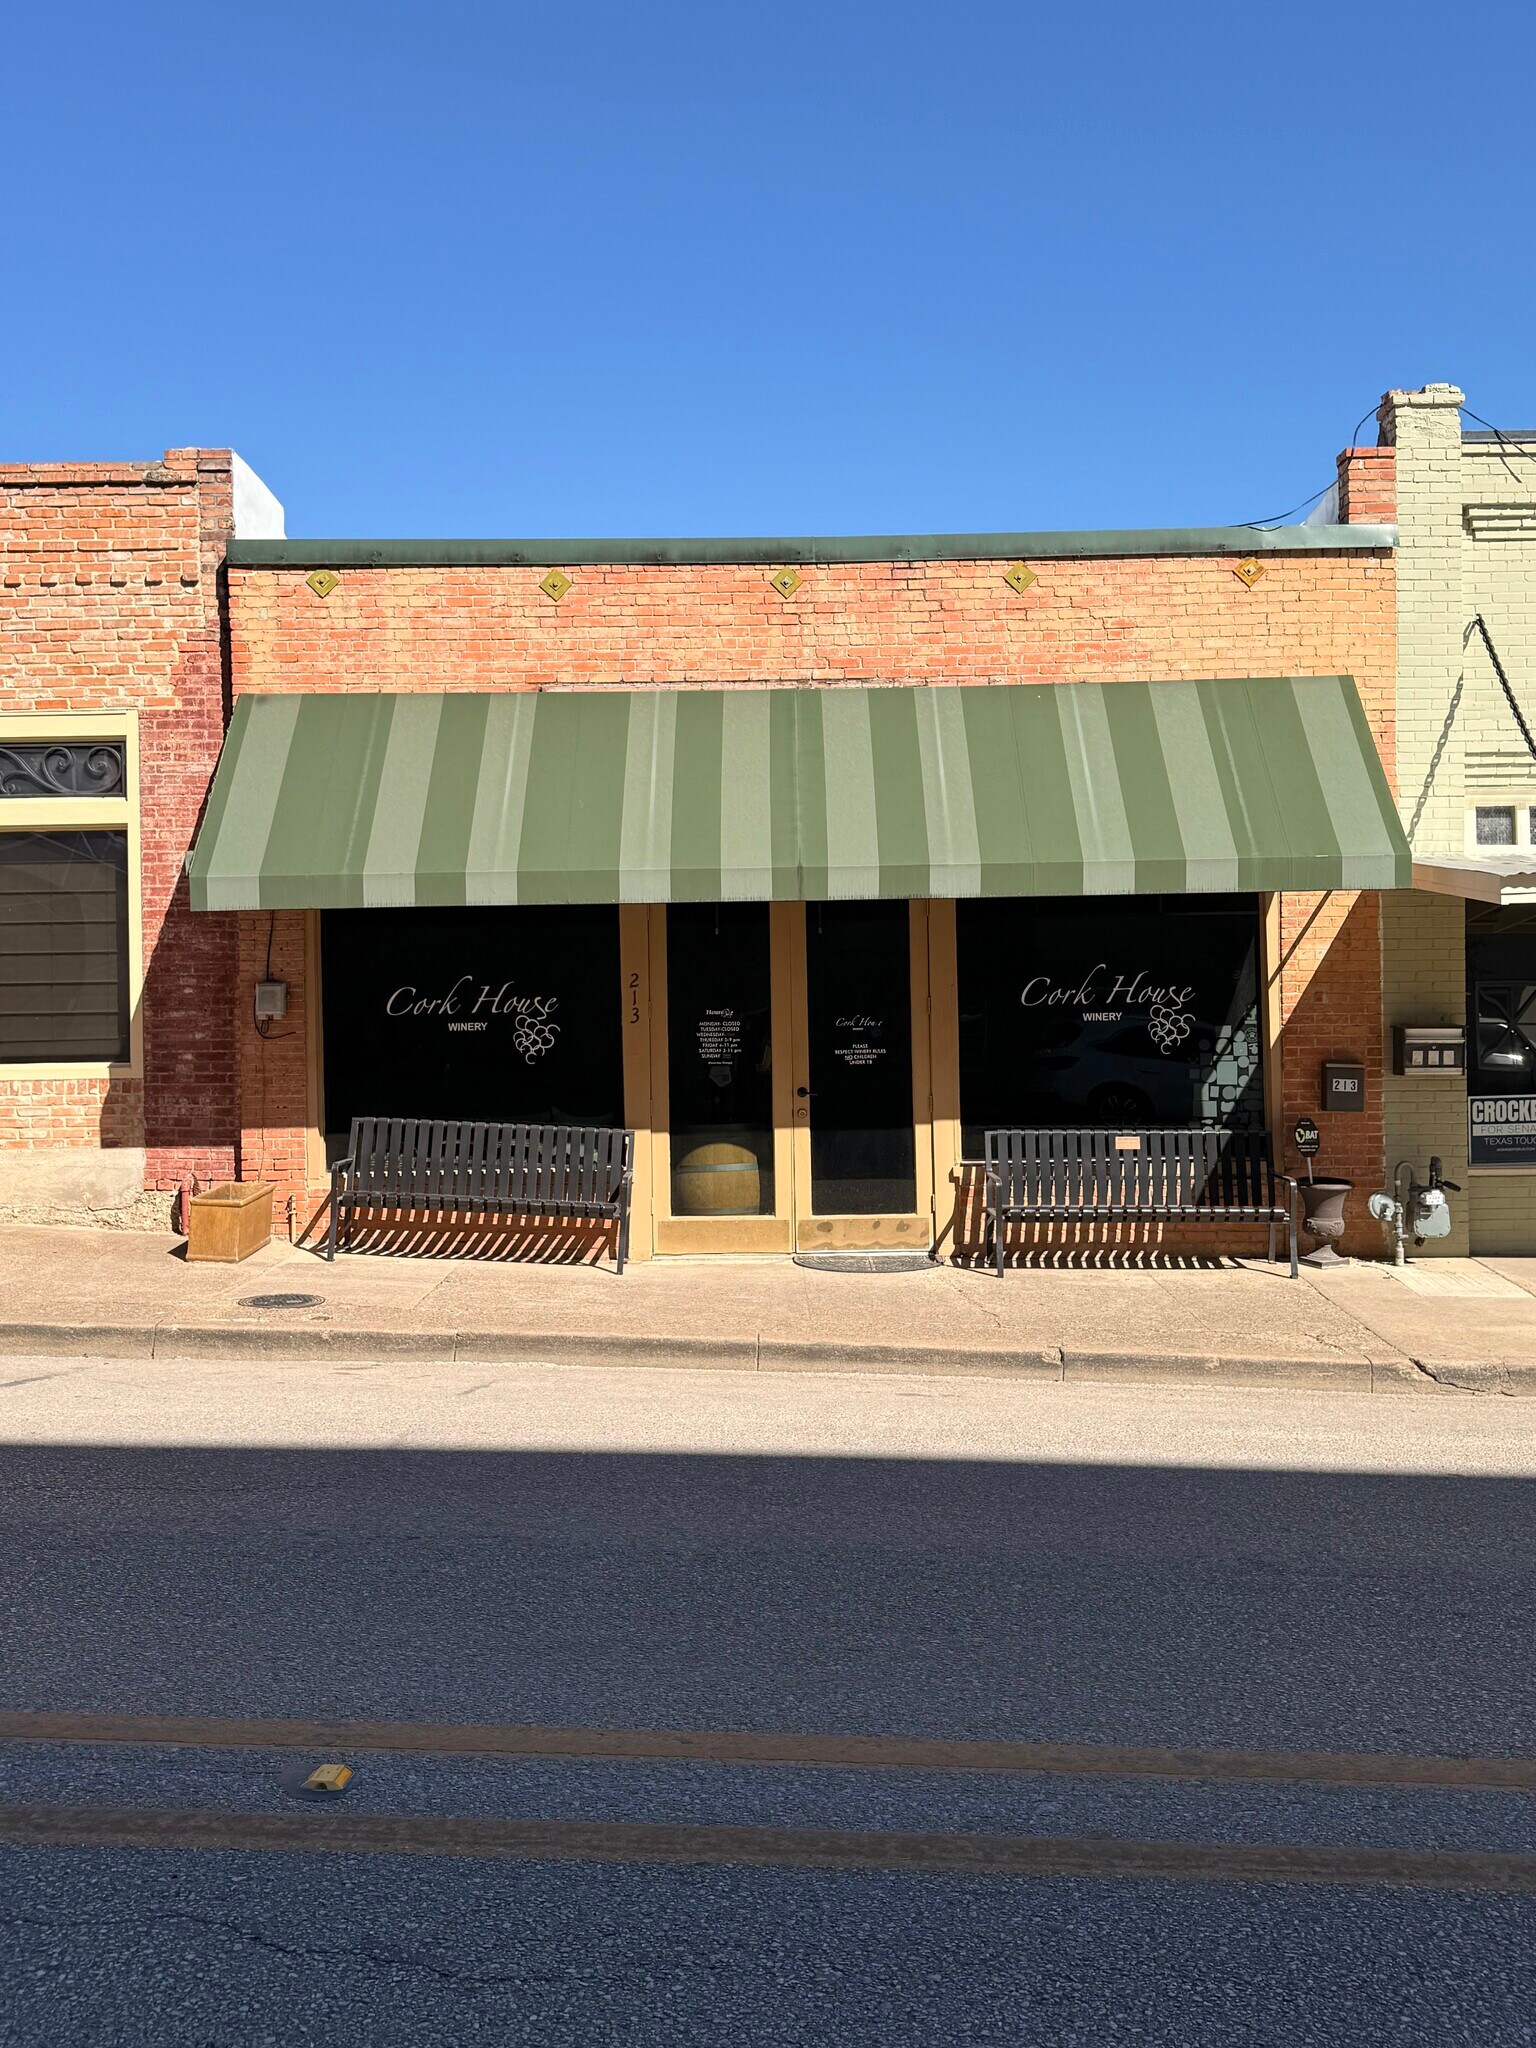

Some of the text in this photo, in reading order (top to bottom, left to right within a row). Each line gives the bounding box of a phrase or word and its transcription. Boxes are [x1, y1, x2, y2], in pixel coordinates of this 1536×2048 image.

[1021, 963, 1195, 1010] Cork House
[386, 975, 559, 1020] Cork House
[629, 973, 640, 1024] 213
[1082, 1012, 1122, 1021] WINERY
[448, 1022, 488, 1031] WINERY
[1334, 1080, 1356, 1091] 213
[1305, 1130, 1319, 1139] BAT
[1481, 1125, 1503, 1135] FOR
[1484, 1137, 1513, 1146] TEXAS
